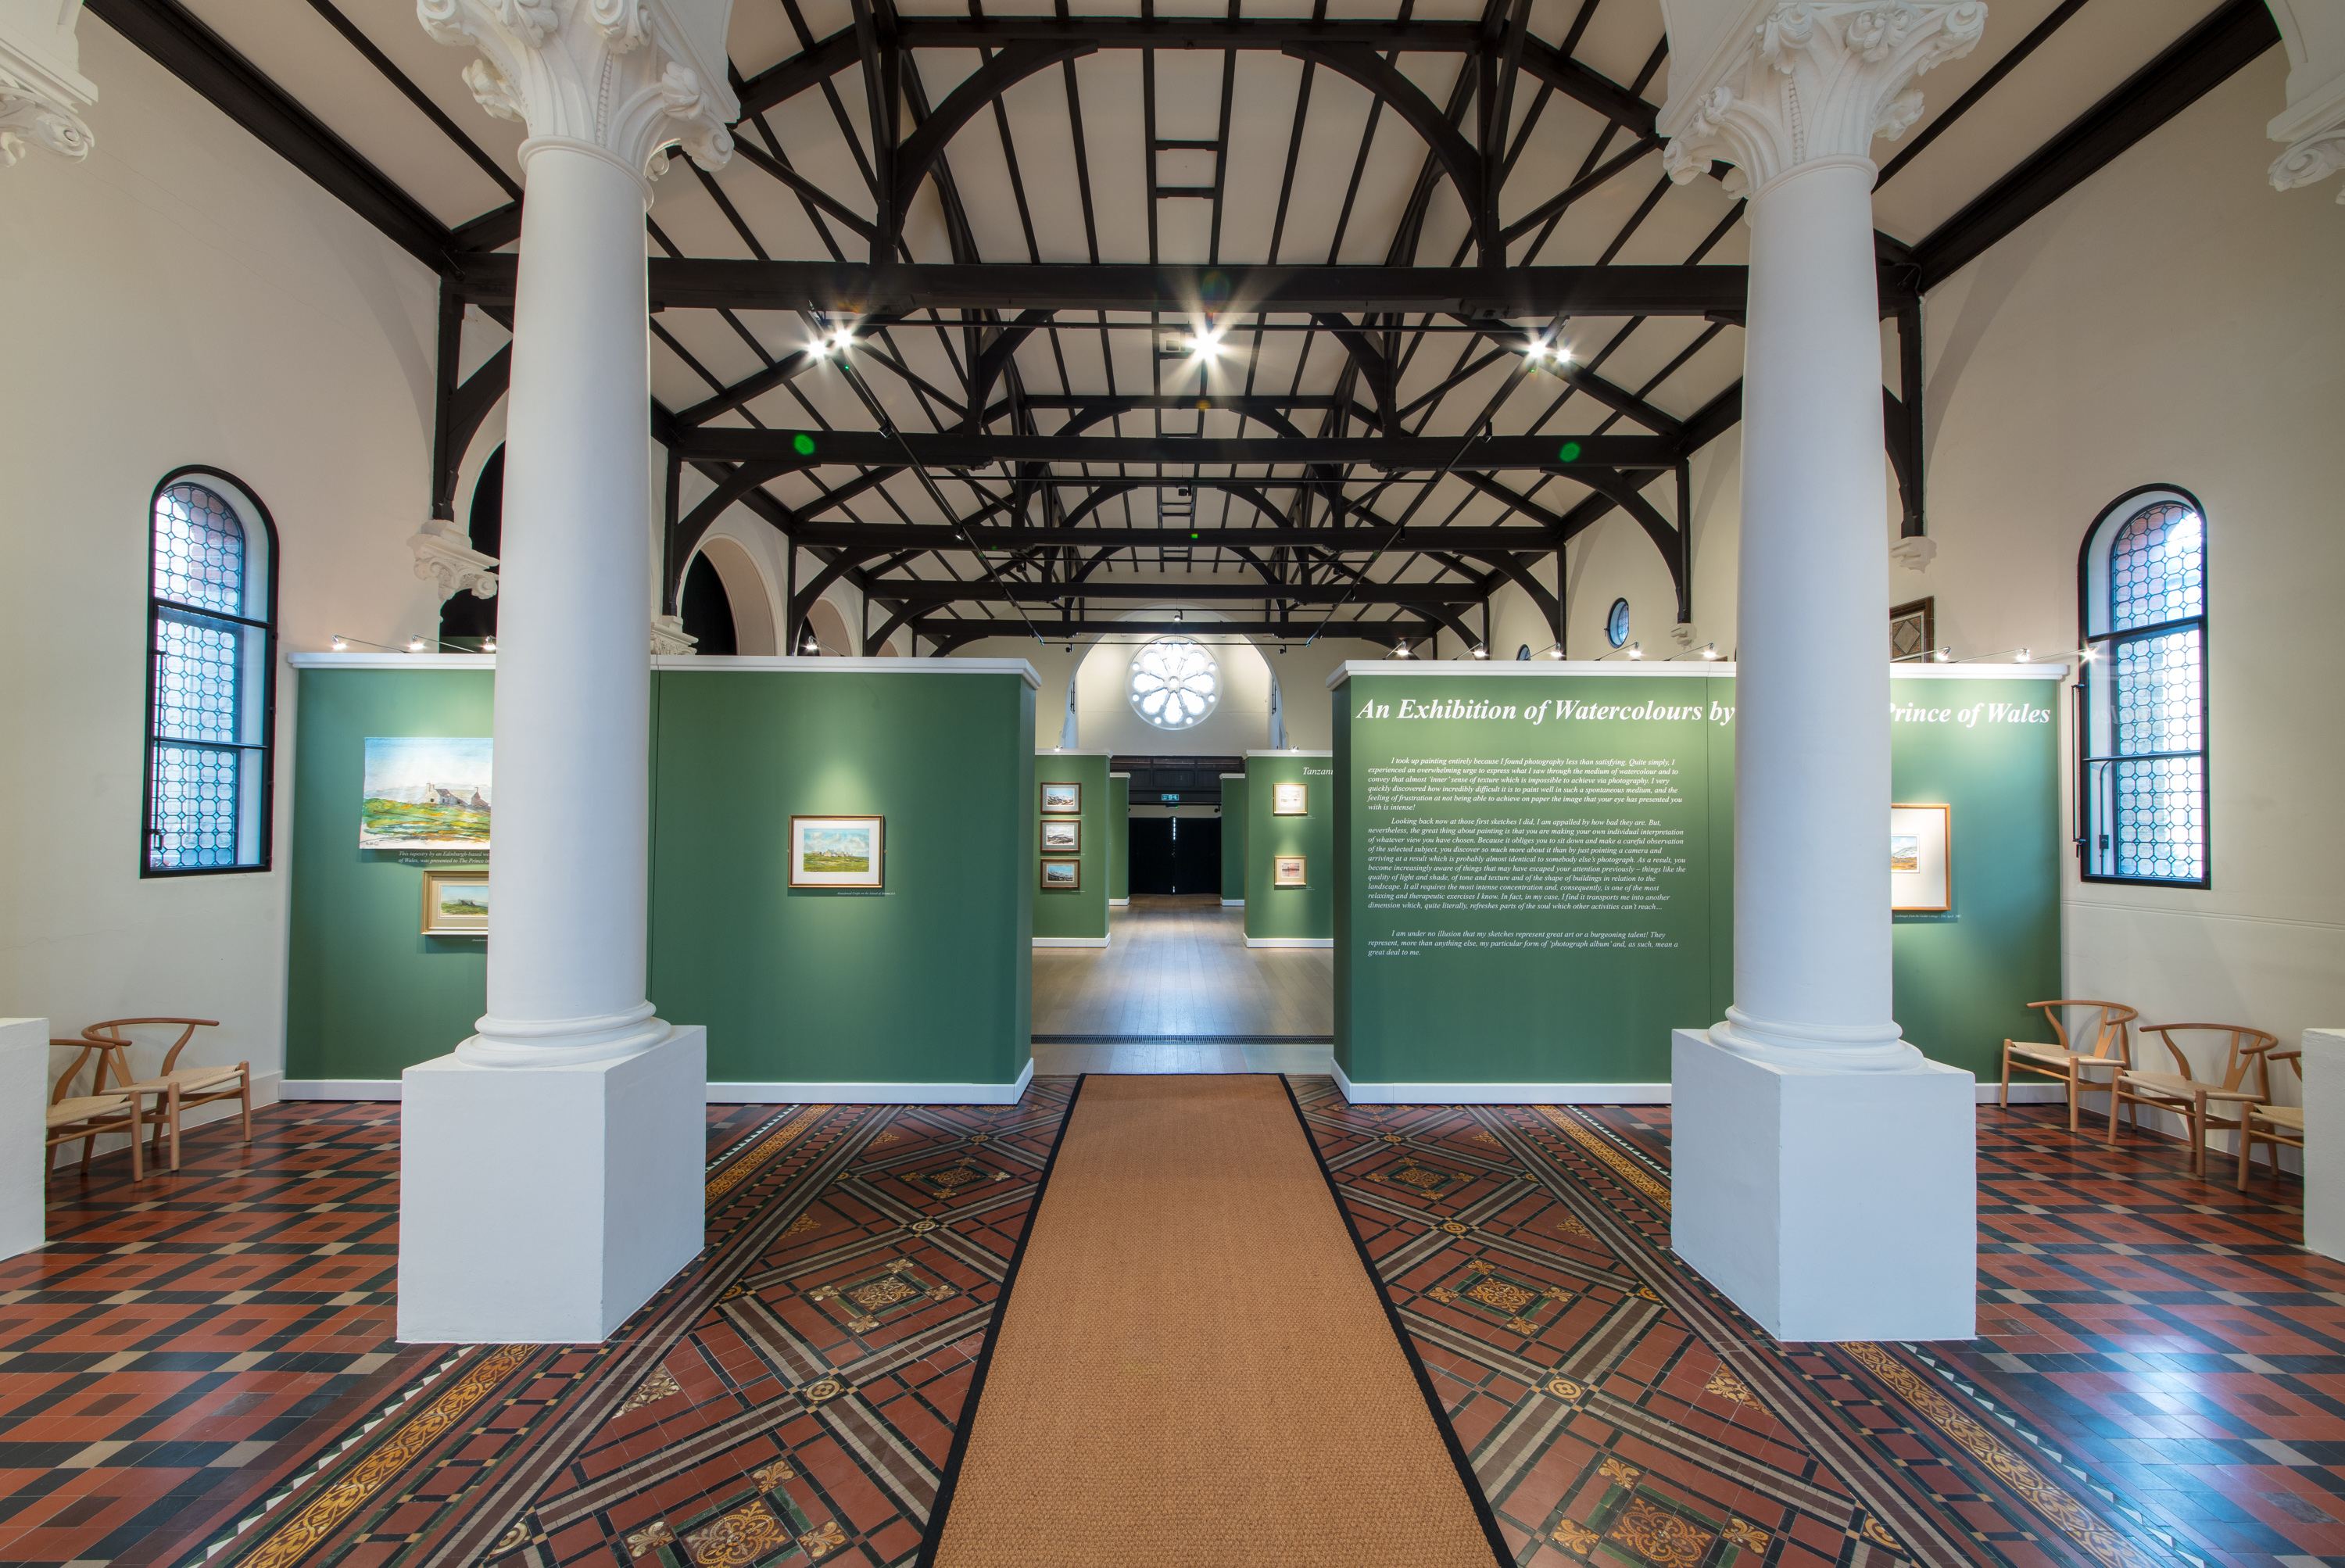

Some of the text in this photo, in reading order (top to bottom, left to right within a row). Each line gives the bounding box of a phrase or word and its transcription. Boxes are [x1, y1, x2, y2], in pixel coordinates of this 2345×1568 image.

[1356, 699, 1390, 718] An
[1396, 699, 1516, 719] Exhibition
[1524, 700, 1552, 725] of
[1556, 700, 1702, 721] Watercolours
[1709, 700, 1735, 725] by
[1957, 702, 1985, 729] of
[1988, 703, 2050, 723] Wales
[1420, 757, 1447, 767] painting
[1448, 757, 1473, 767] entirely
[1504, 758, 1523, 767] found
[1524, 758, 1565, 768] photography
[1595, 758, 1627, 768] satisfying.
[1648, 759, 1670, 768] simply,
[1368, 766, 1406, 775] experienced
[1417, 767, 1462, 775] overwhelming
[1547, 767, 1571, 776] through
[1611, 768, 1619, 776] of
[1470, 776, 1477, 785] of
[1528, 776, 1562, 786] impossible
[1608, 777, 1649, 786] photography.
[1368, 785, 1391, 794] quickly
[1442, 785, 1474, 794] incredibly
[1475, 786, 1500, 794] difficult
[1522, 786, 1539, 795] paint
[1585, 786, 1624, 795] spontaneous
[1366, 794, 1390, 804] feeling
[1391, 794, 1398, 804] of
[1398, 794, 1433, 804] frustration
[1454, 794, 1472, 804] being
[1563, 795, 1583, 804] image
[1638, 796, 1670, 804] presented
[1516, 931, 1545, 940] represent
[1546, 931, 1563, 940] great
[1590, 931, 1626, 940] burgeoning
[1651, 931, 1666, 940] They
[1368, 940, 1398, 948] represent,
[1434, 940, 1462, 949] anything
[1463, 940, 1477, 948] else,
[1490, 940, 1523, 949] particular
[1523, 940, 1539, 949] form
[1541, 940, 1548, 949] of
[1613, 940, 1626, 949] and,
[1637, 940, 1653, 949] such,
[1367, 949, 1385, 958] great
